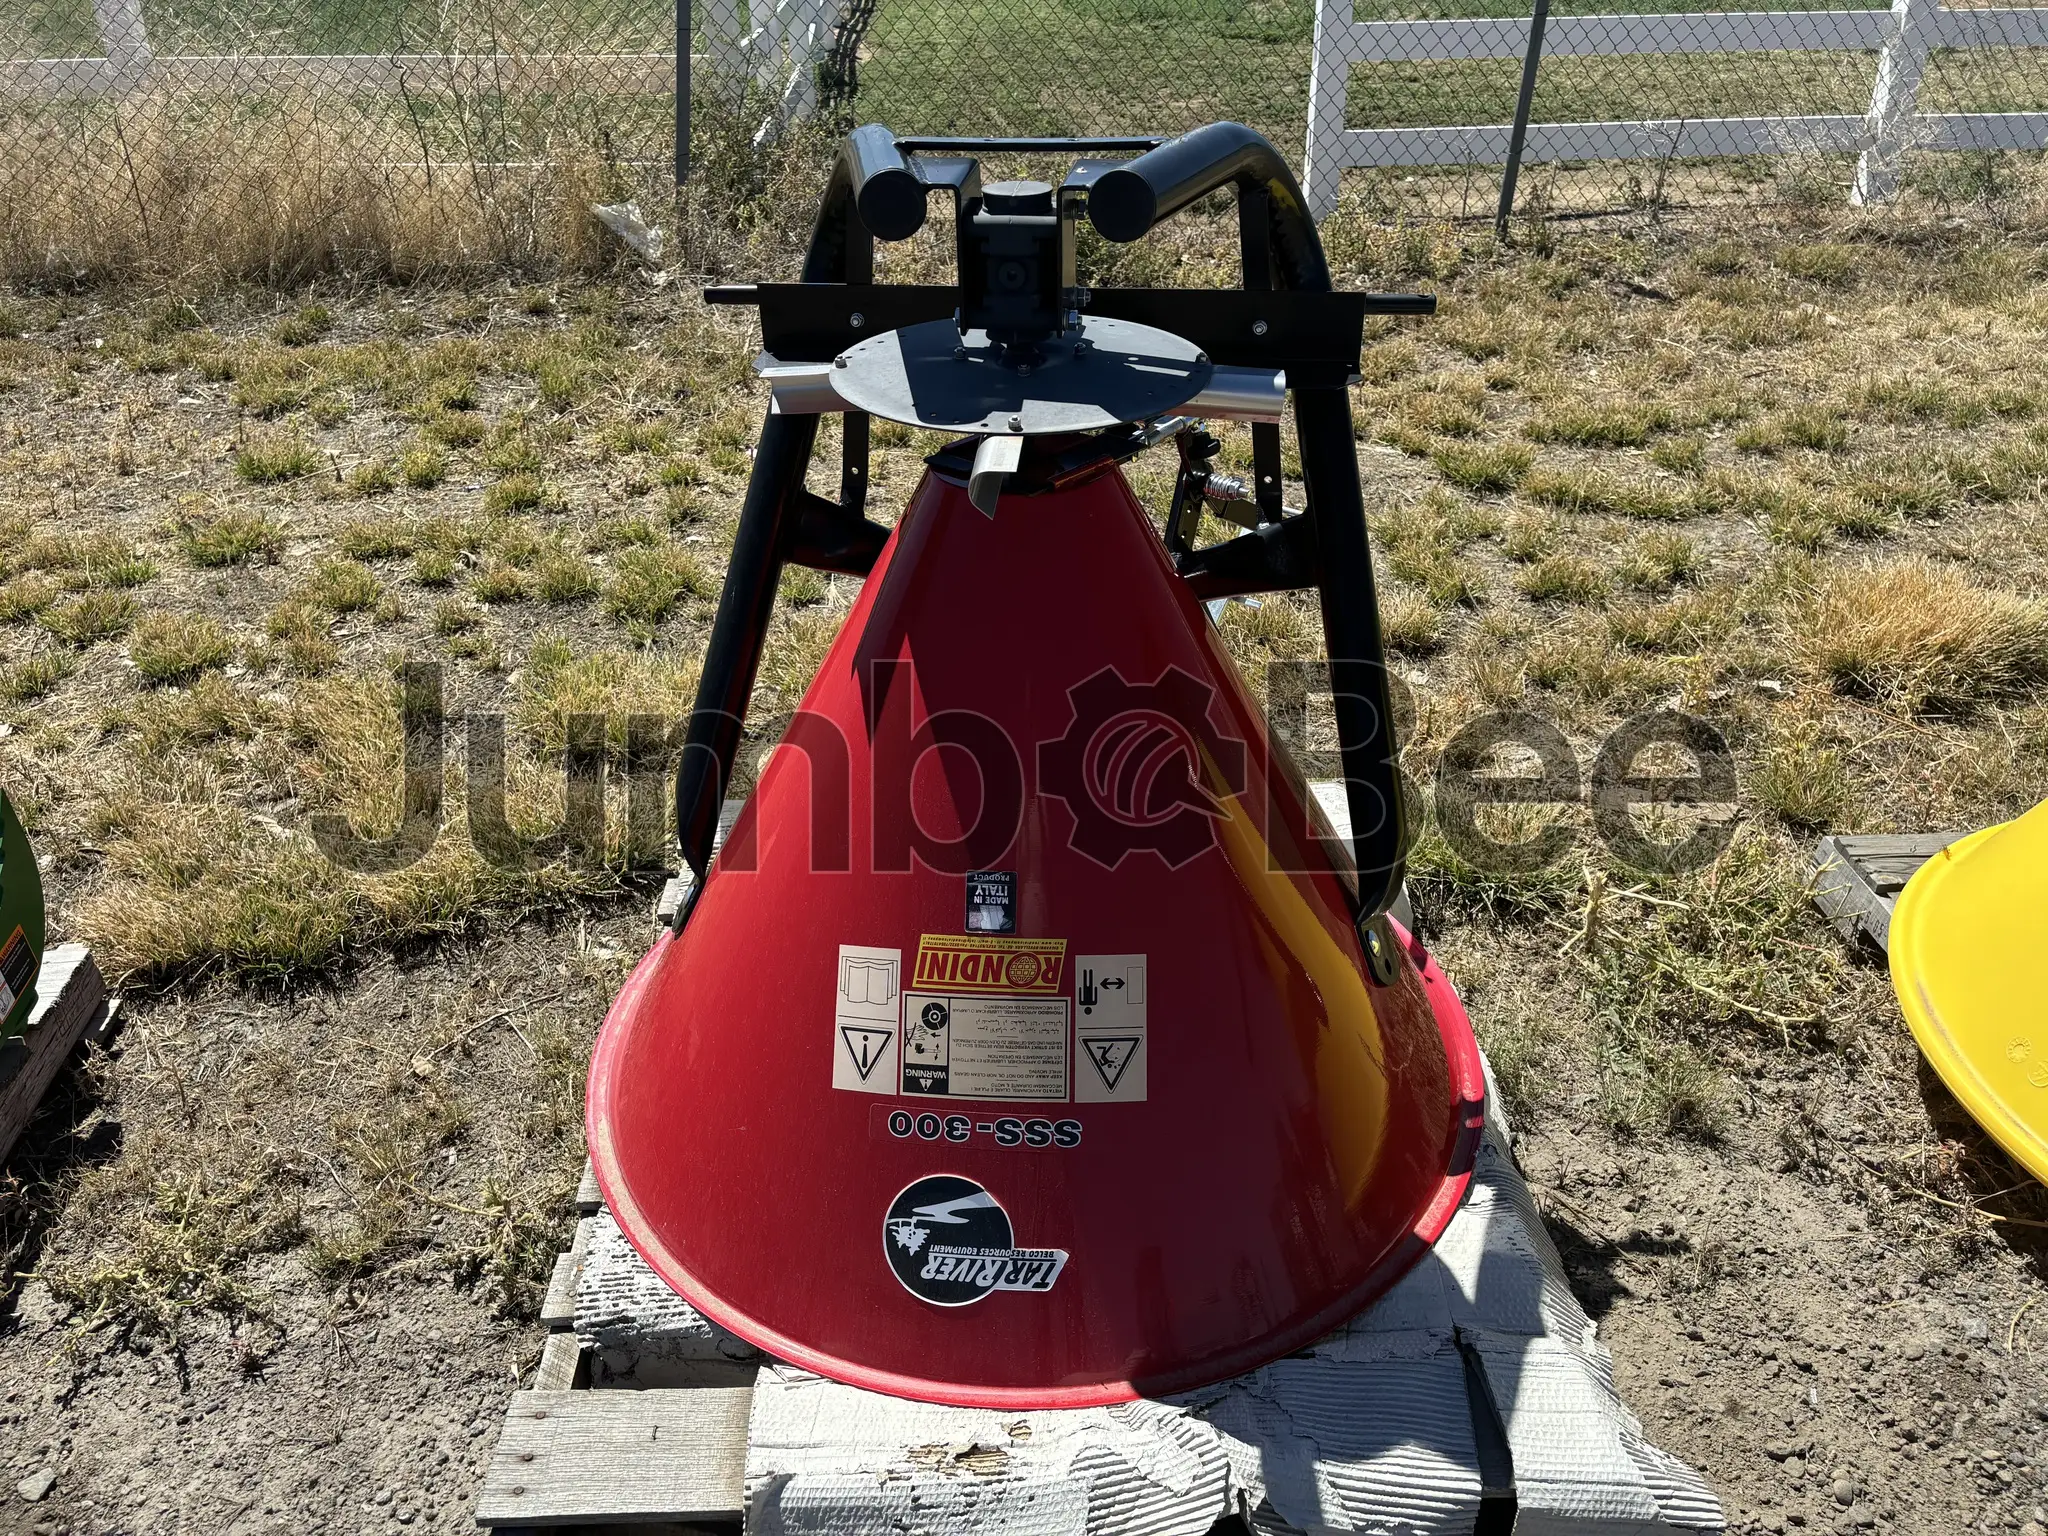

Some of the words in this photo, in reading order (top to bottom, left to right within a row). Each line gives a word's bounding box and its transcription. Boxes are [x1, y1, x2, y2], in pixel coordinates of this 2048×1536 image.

[974, 874, 1010, 882] PRODUCT
[975, 885, 1008, 896] ITALY
[974, 896, 982, 904] IN
[984, 896, 1009, 905] MADE
[917, 952, 1062, 988] RONDINI
[905, 1068, 947, 1080] WARNING
[928, 1244, 978, 1255] EQUIPMENT
[980, 1248, 1026, 1258] RESOURCES
